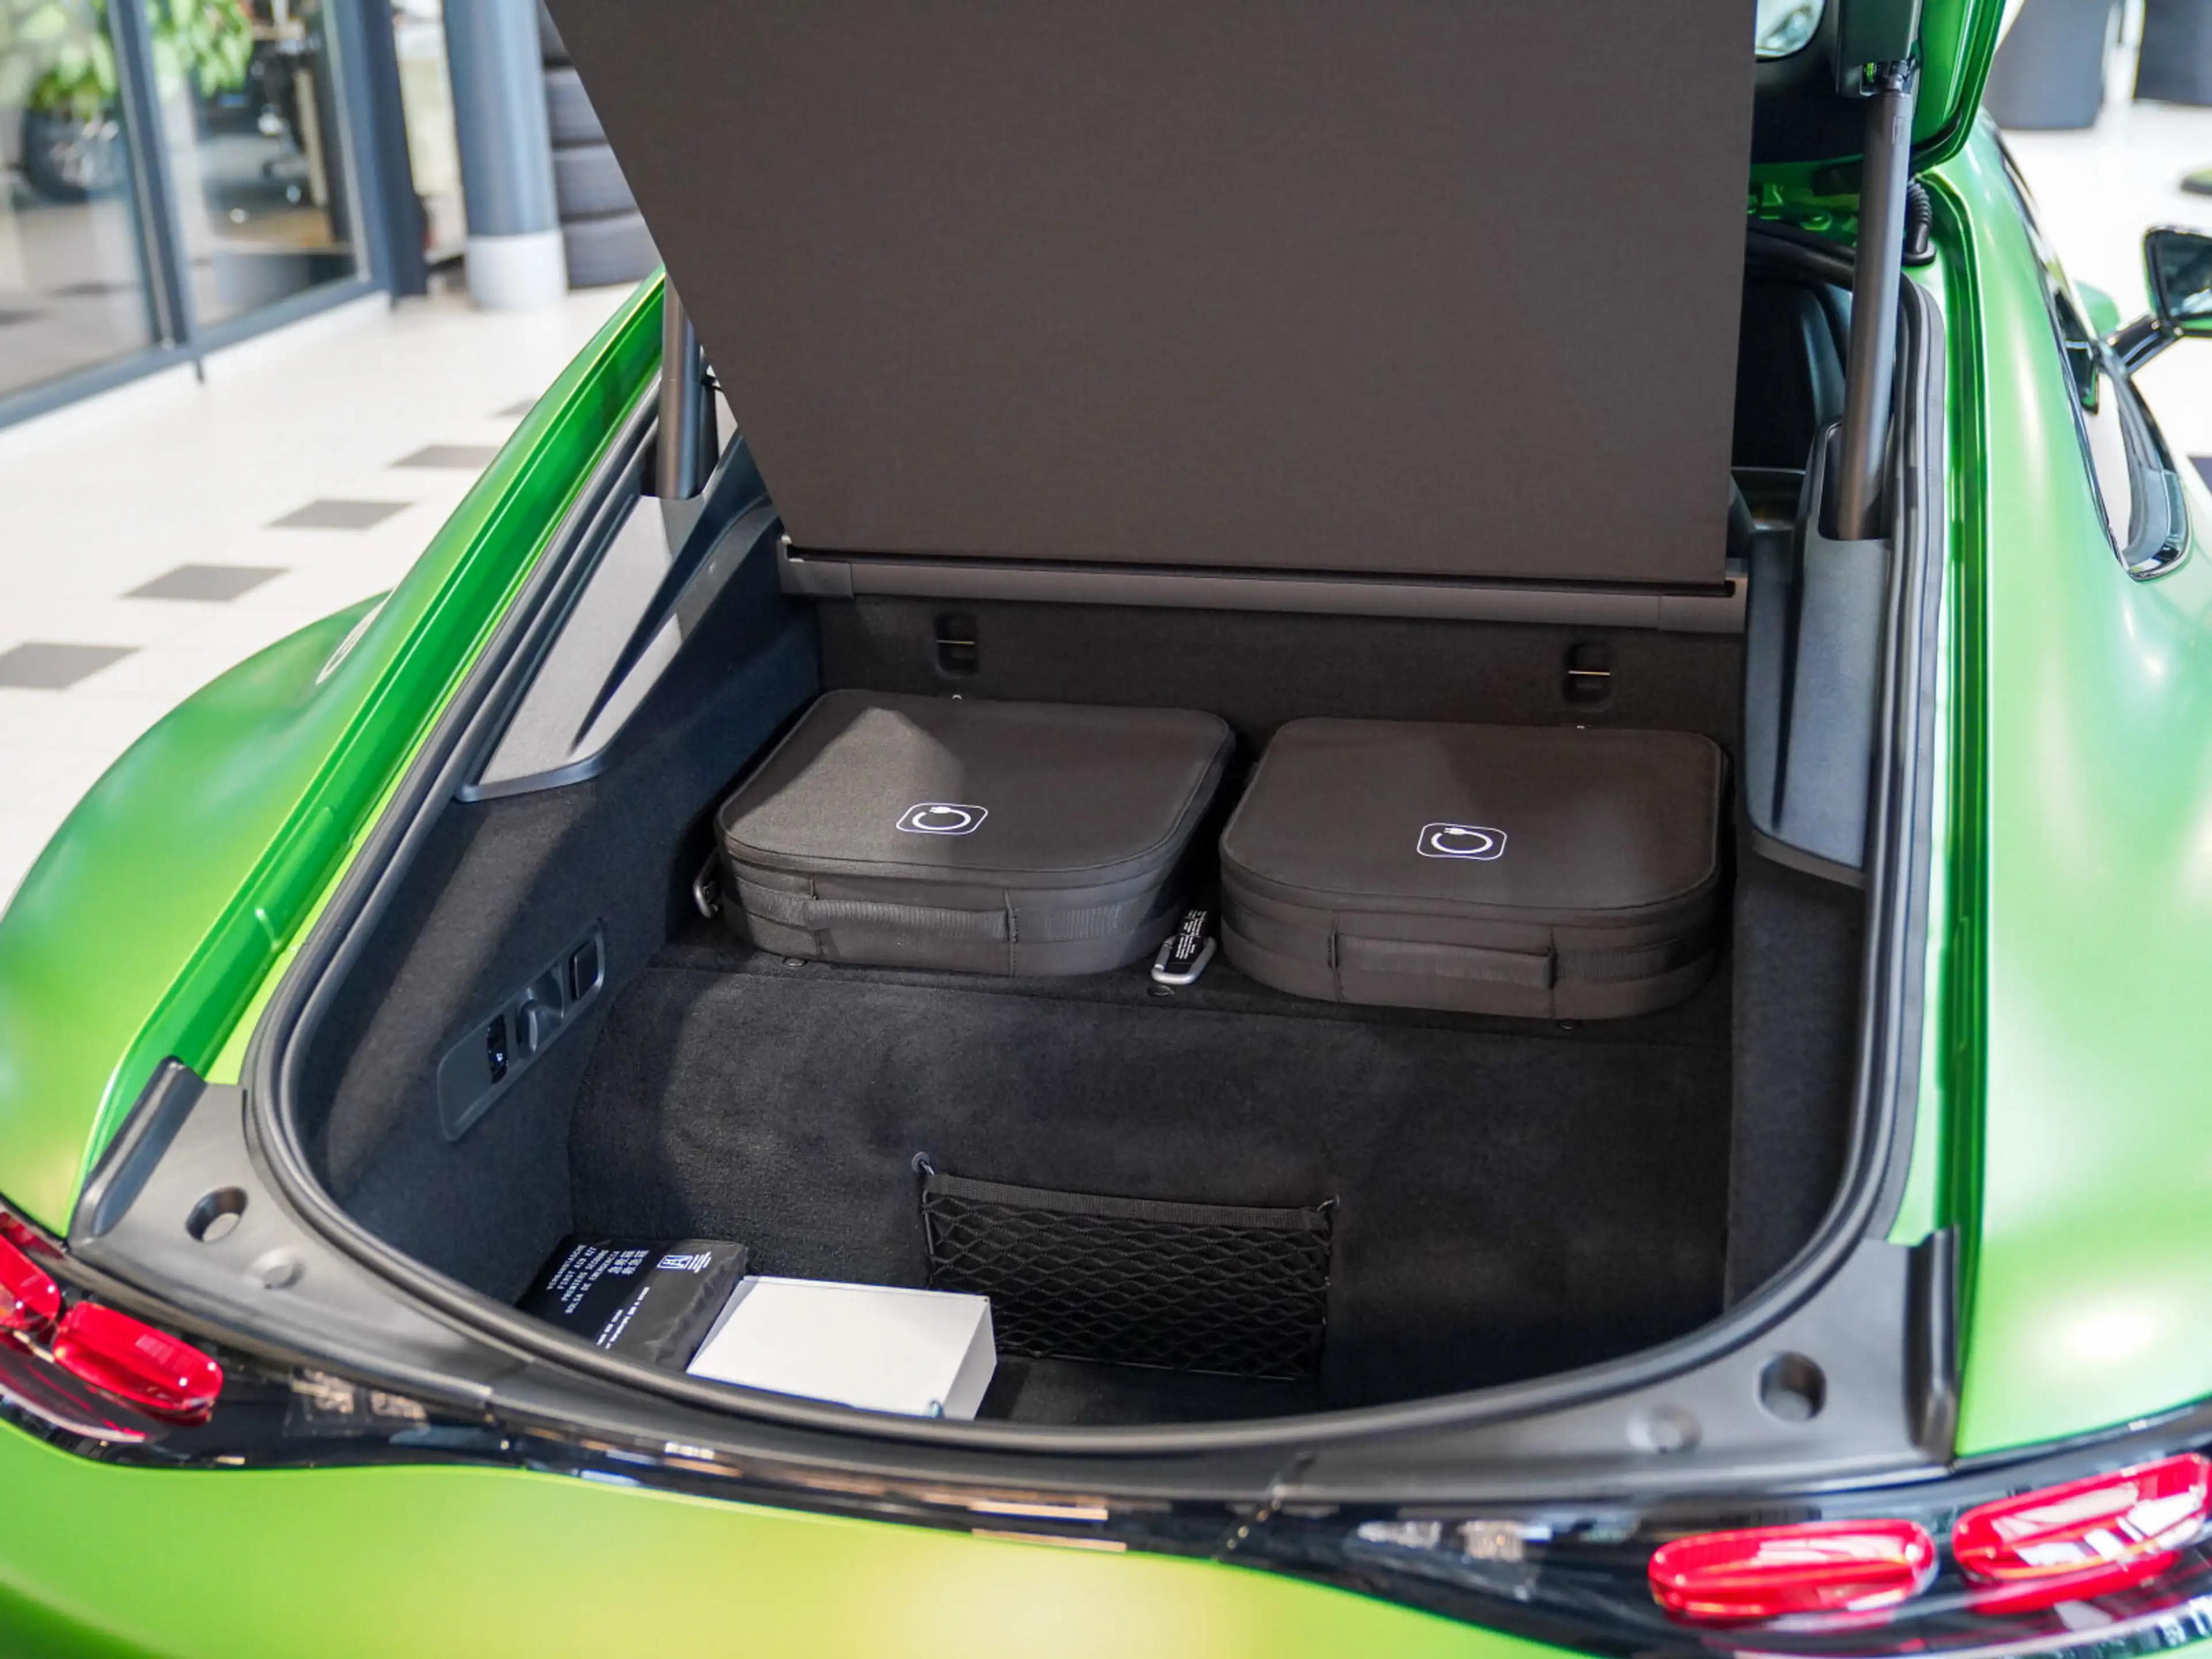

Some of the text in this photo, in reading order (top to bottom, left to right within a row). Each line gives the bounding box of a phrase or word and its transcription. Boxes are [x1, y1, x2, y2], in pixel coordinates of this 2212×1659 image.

[557, 1247, 597, 1290] FIRST AID KIT
[561, 1272, 588, 1301] PREMIERS
[565, 1294, 585, 1315] BOLSA
[580, 1283, 592, 1291] DE
